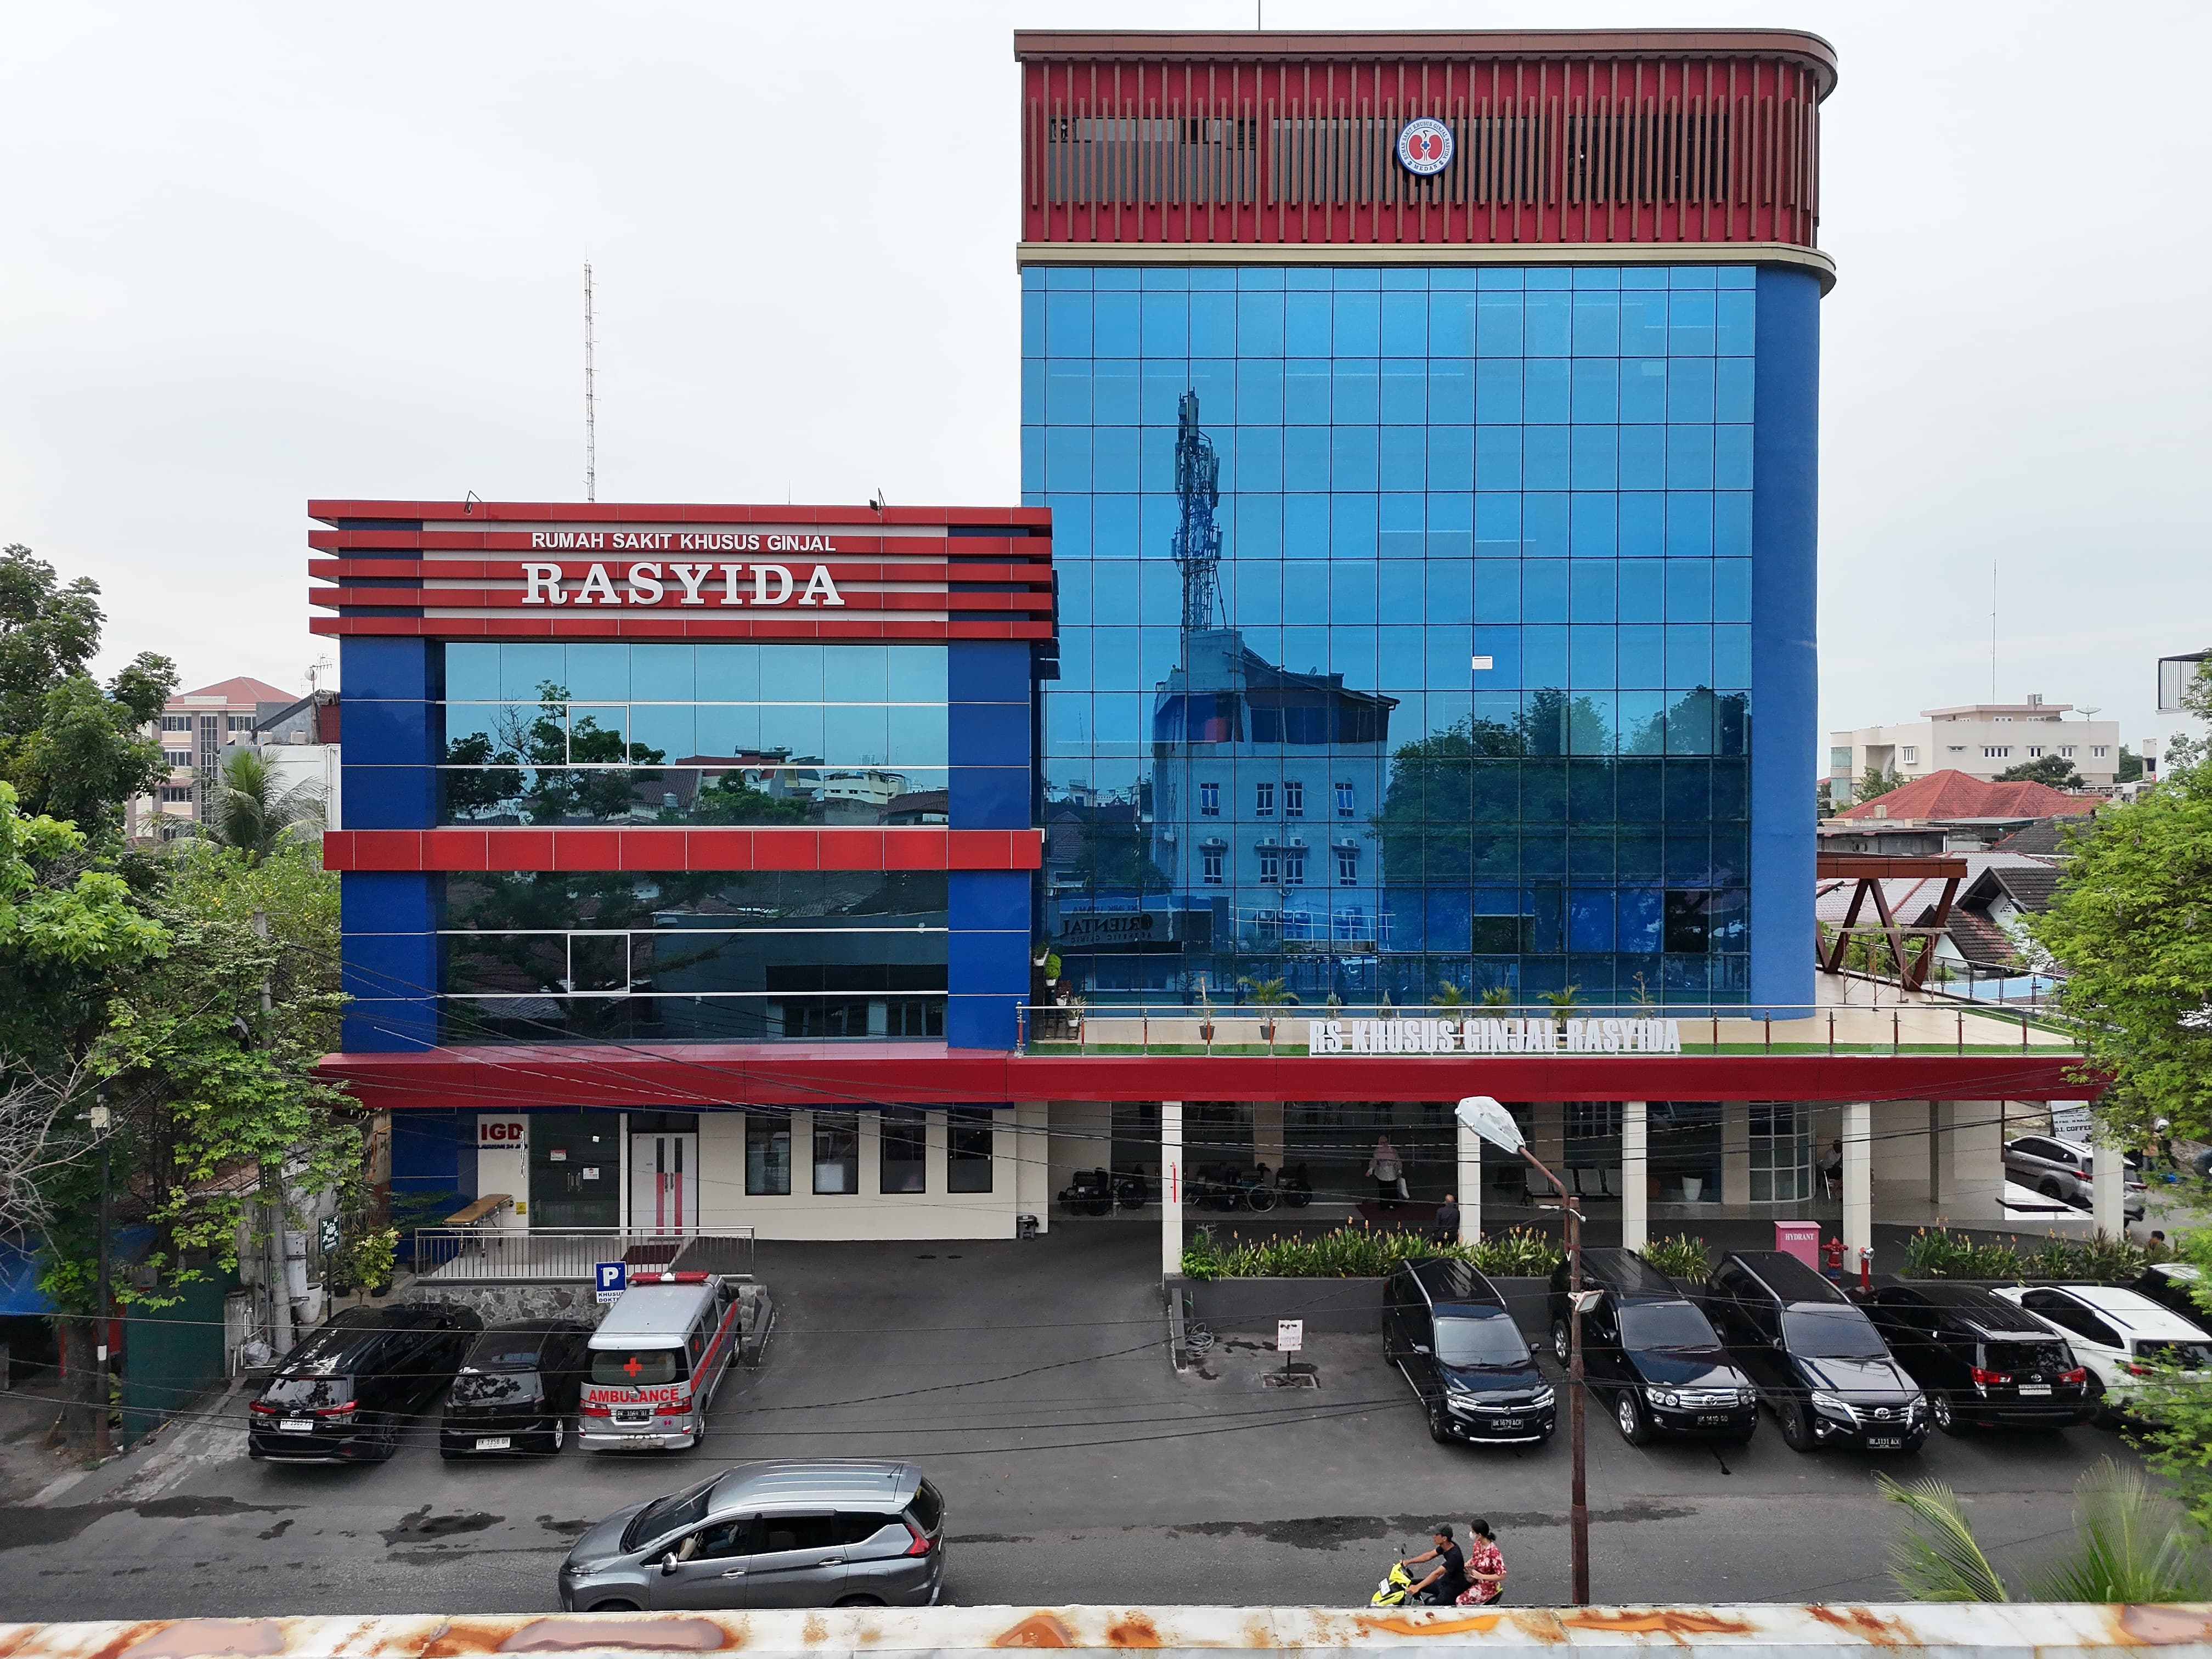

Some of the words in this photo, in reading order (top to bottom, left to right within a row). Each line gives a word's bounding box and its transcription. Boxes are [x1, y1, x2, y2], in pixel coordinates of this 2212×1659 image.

[1403, 127, 1413, 142] SAKIT
[1433, 123, 1448, 138] GINJAL
[532, 532, 603, 549] RUMAH
[612, 533, 672, 549] SAKIT
[680, 534, 760, 551] KHUSUS
[767, 535, 836, 551] GINJAL
[521, 562, 845, 605] RASYIDA
[1310, 1020, 1342, 1053] RS
[1352, 1020, 1455, 1053] KHUSUS
[1464, 1020, 1557, 1053] GINJAL
[1566, 1019, 1681, 1053] RASYIDA
[481, 1123, 523, 1140] IGD
[603, 1267, 619, 1286] P
